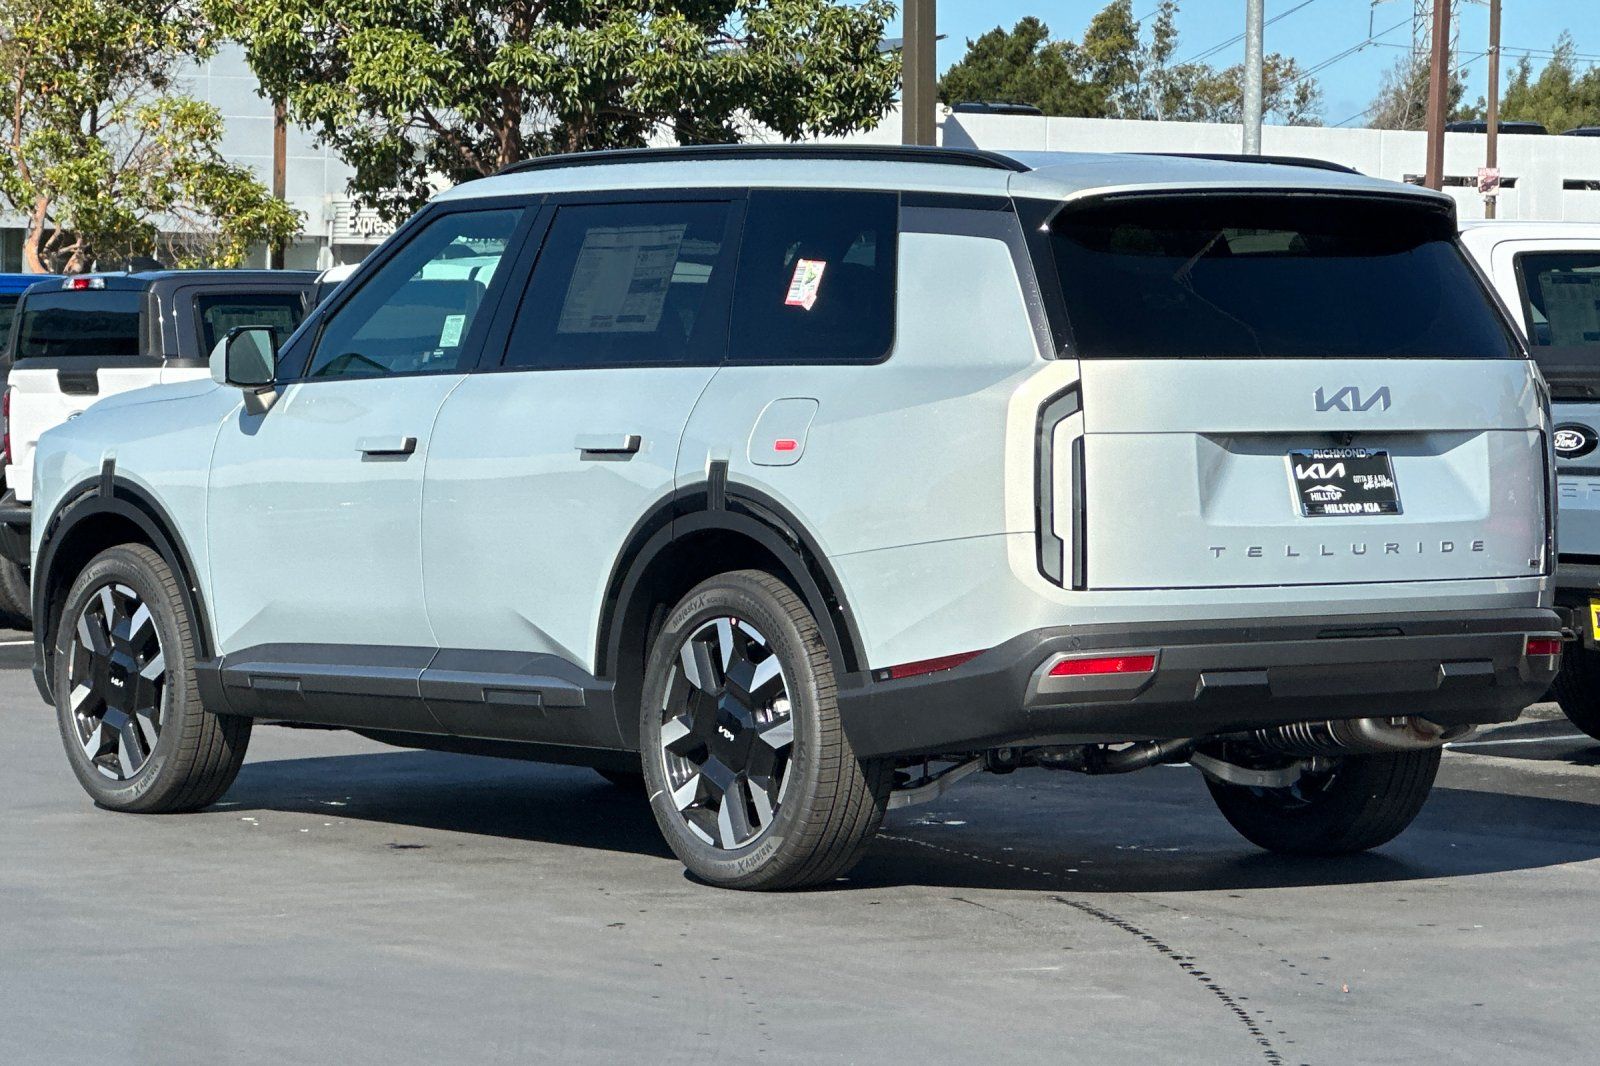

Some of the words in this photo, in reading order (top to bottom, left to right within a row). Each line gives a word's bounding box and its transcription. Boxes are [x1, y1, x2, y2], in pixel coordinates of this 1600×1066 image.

[347, 211, 397, 238] Express
[1313, 386, 1391, 412] KIA
[1554, 432, 1577, 448] Ford
[1313, 448, 1367, 459] RICHMOND
[1295, 462, 1346, 479] KIA
[1310, 490, 1342, 501] HILLTOP
[1324, 502, 1362, 514] HILLTOP
[1363, 502, 1381, 513] KIA
[1209, 540, 1485, 558] TELLURIDE
